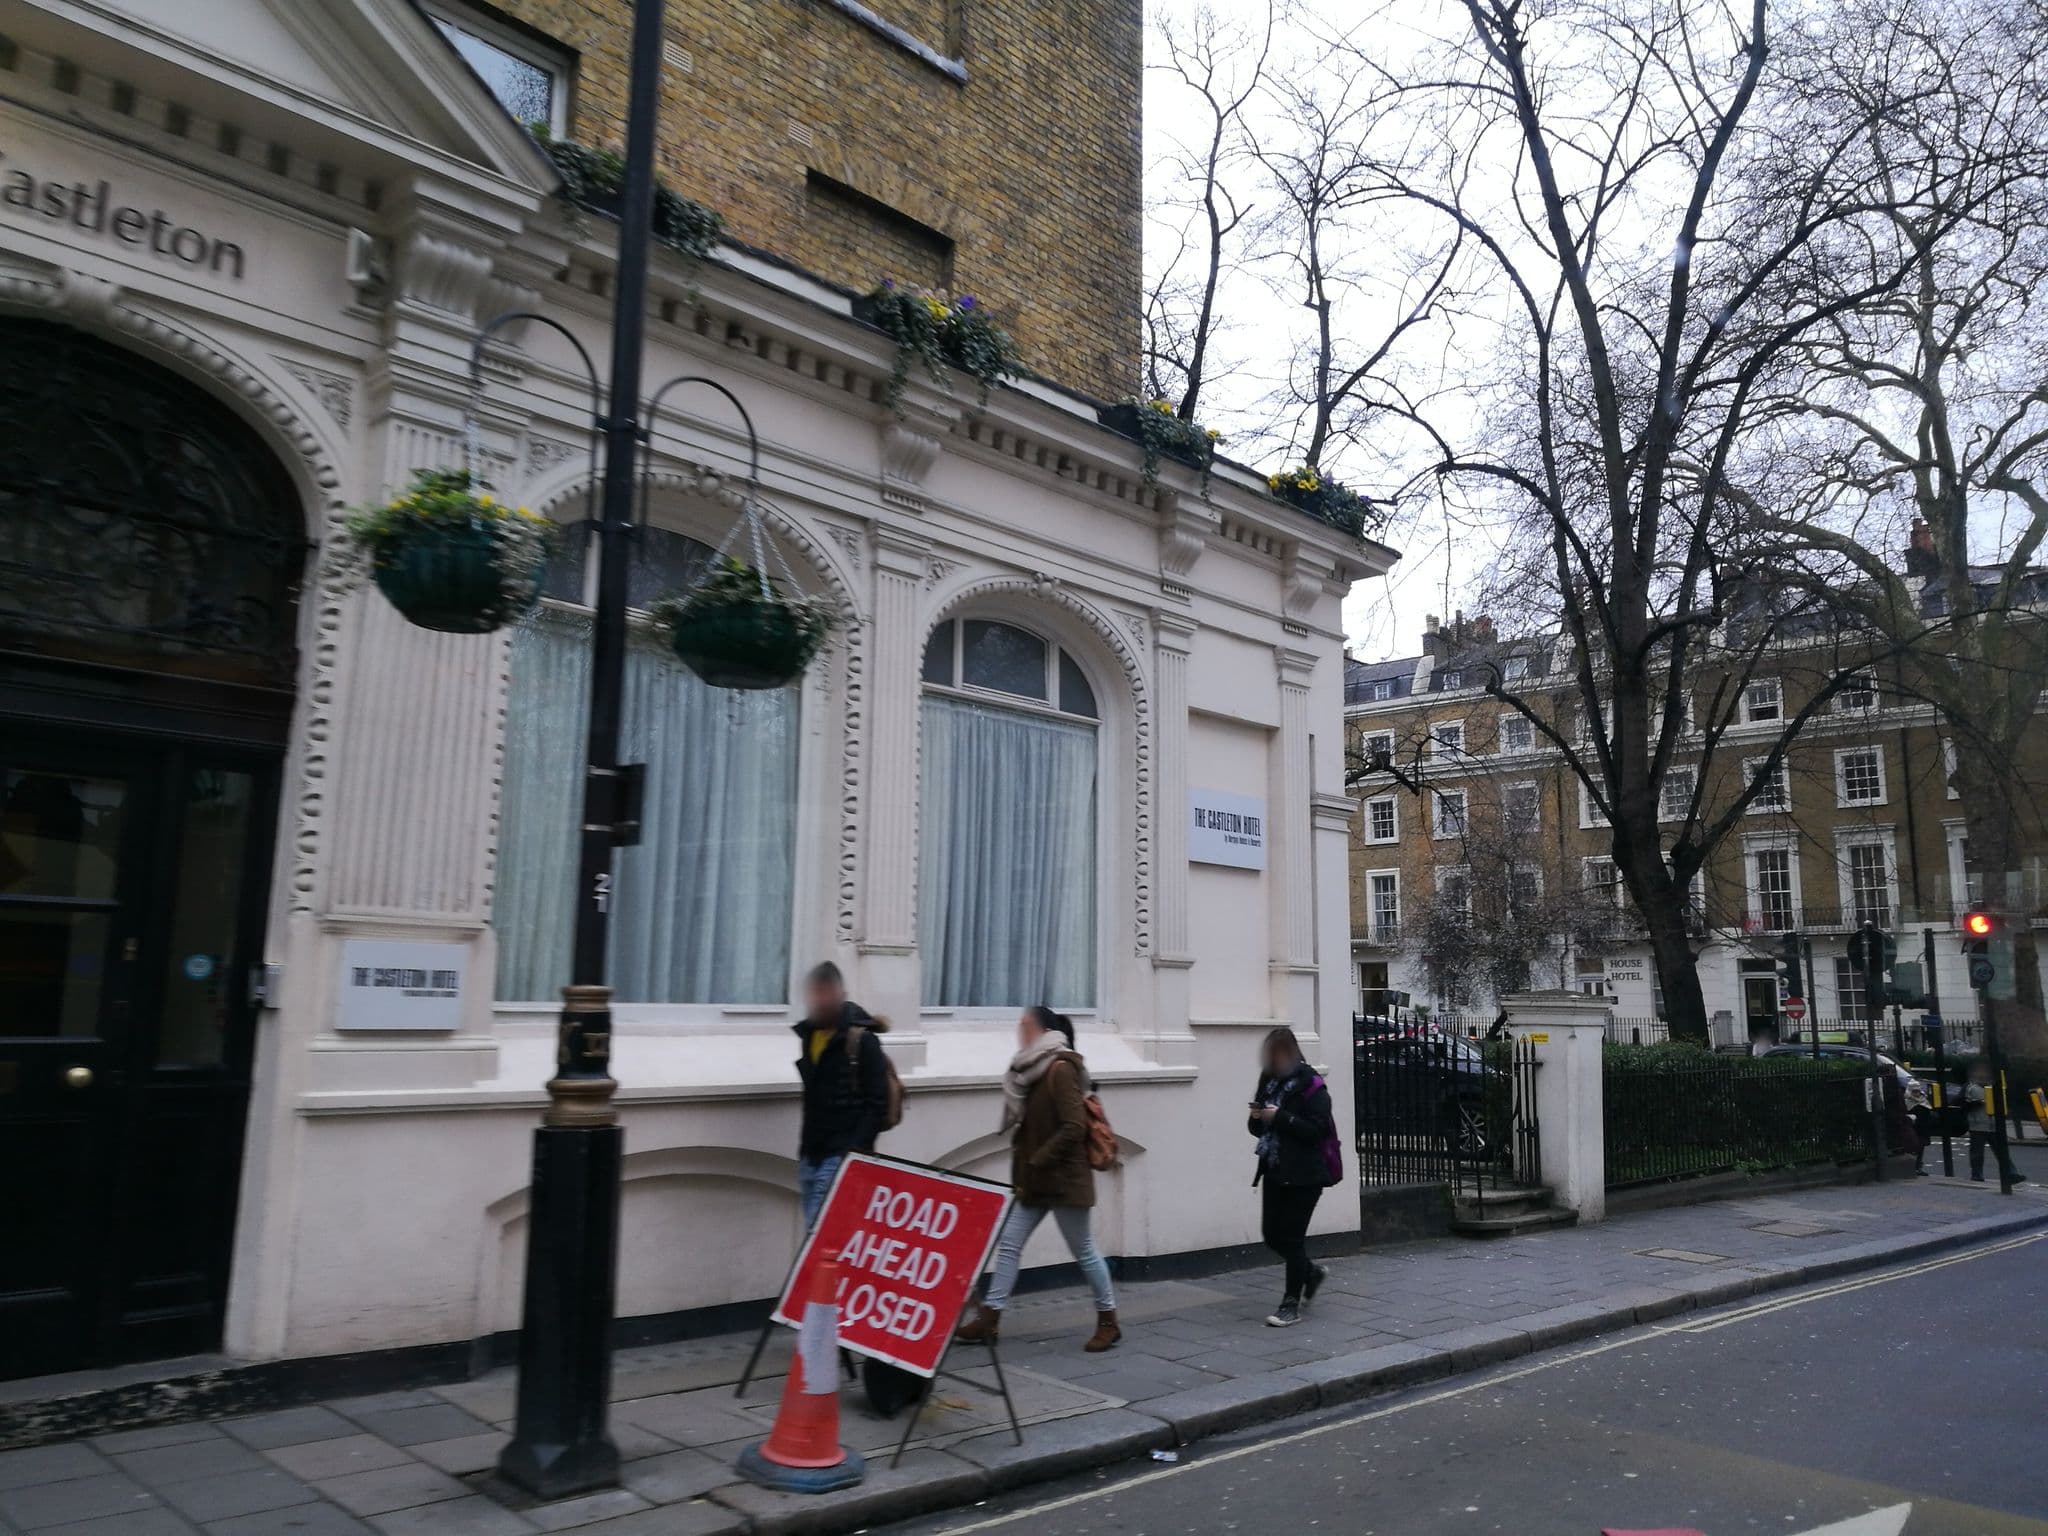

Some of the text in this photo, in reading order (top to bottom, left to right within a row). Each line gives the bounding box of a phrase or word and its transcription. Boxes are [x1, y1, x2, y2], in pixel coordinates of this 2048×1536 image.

[0, 168, 244, 279] astleton
[1194, 807, 1261, 837] THE CASTLETON HOTEL
[1610, 959, 1643, 968] HOUSE
[1611, 972, 1643, 981] HOTEL
[864, 1185, 959, 1240] ROAD
[837, 1230, 948, 1290] AHEAD
[836, 1277, 936, 1342] LOSED
